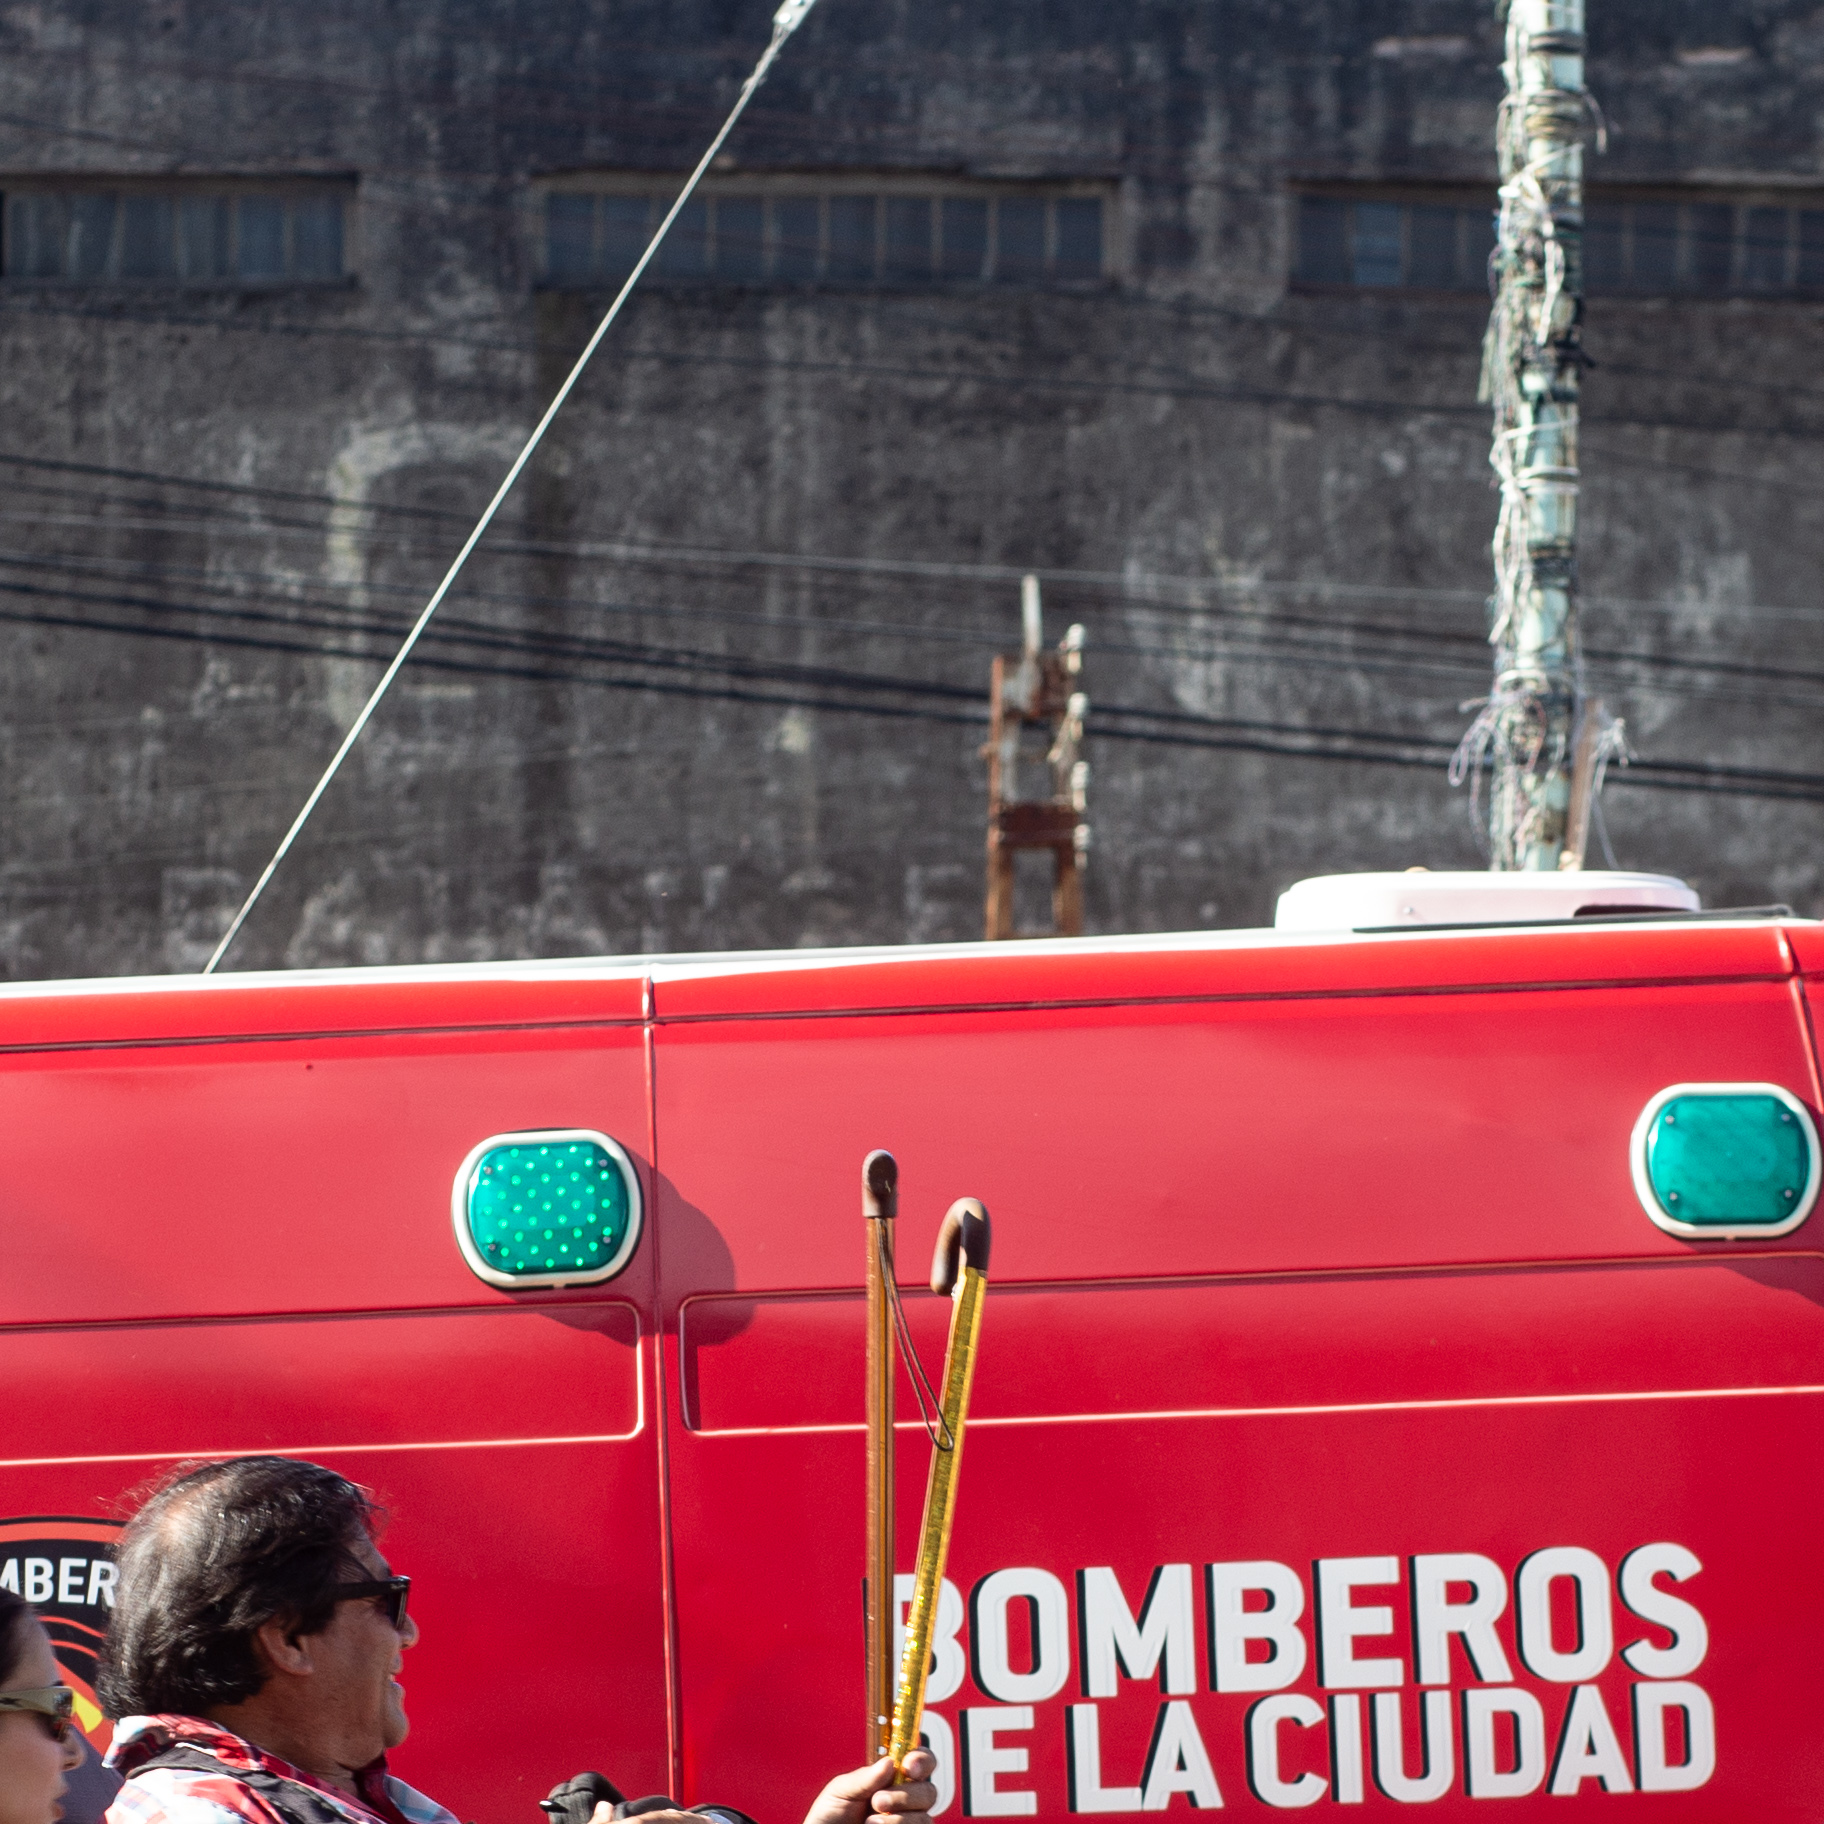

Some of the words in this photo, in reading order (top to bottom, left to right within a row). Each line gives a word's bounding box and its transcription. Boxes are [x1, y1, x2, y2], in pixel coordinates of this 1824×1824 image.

[866, 1541, 1709, 1703] BOMBEROS
[1066, 1698, 1224, 1814] LA
[1244, 1680, 1717, 1809] CIUDAD
